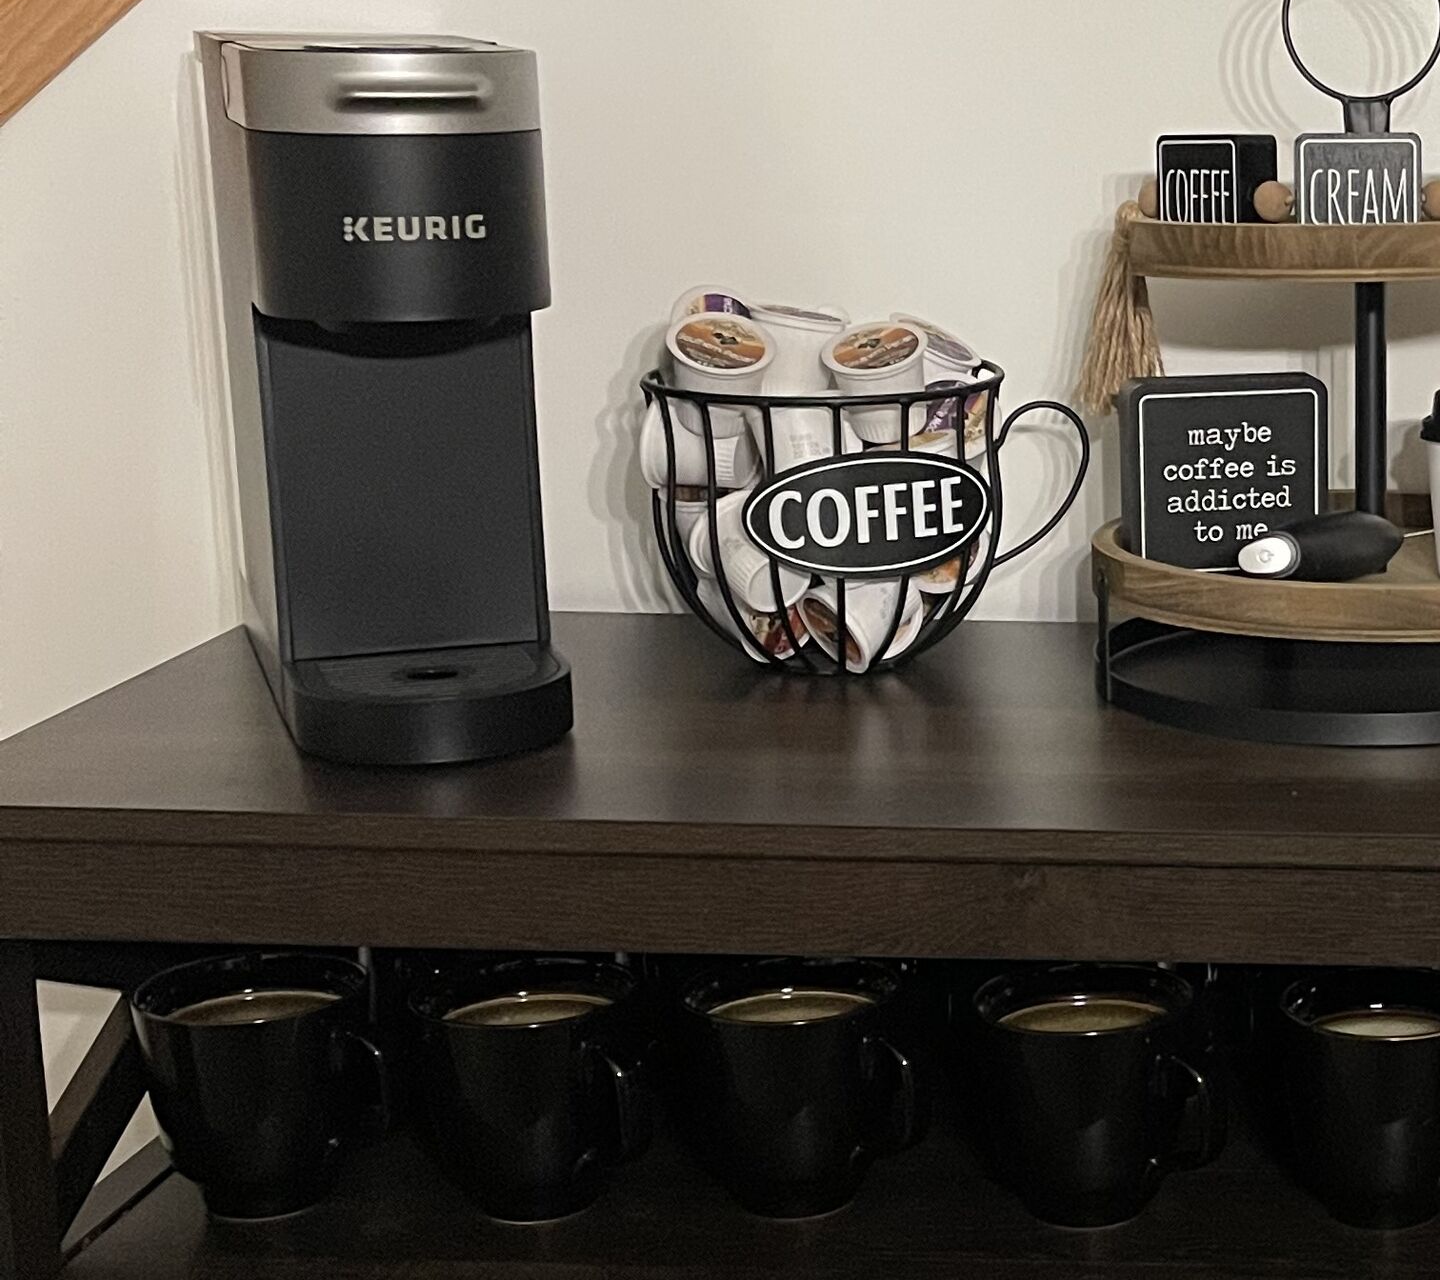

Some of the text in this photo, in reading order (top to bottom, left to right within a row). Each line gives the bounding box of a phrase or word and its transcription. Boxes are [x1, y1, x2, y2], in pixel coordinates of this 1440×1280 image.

[1165, 167, 1230, 224] COFFEE
[1309, 167, 1408, 225] CREAM
[343, 214, 487, 242] KEURIG
[1187, 421, 1272, 451] maybe
[1163, 454, 1297, 481] coffee is
[768, 475, 964, 550] COFFEE
[1167, 485, 1292, 513] addicted
[1194, 520, 1269, 542] to me
